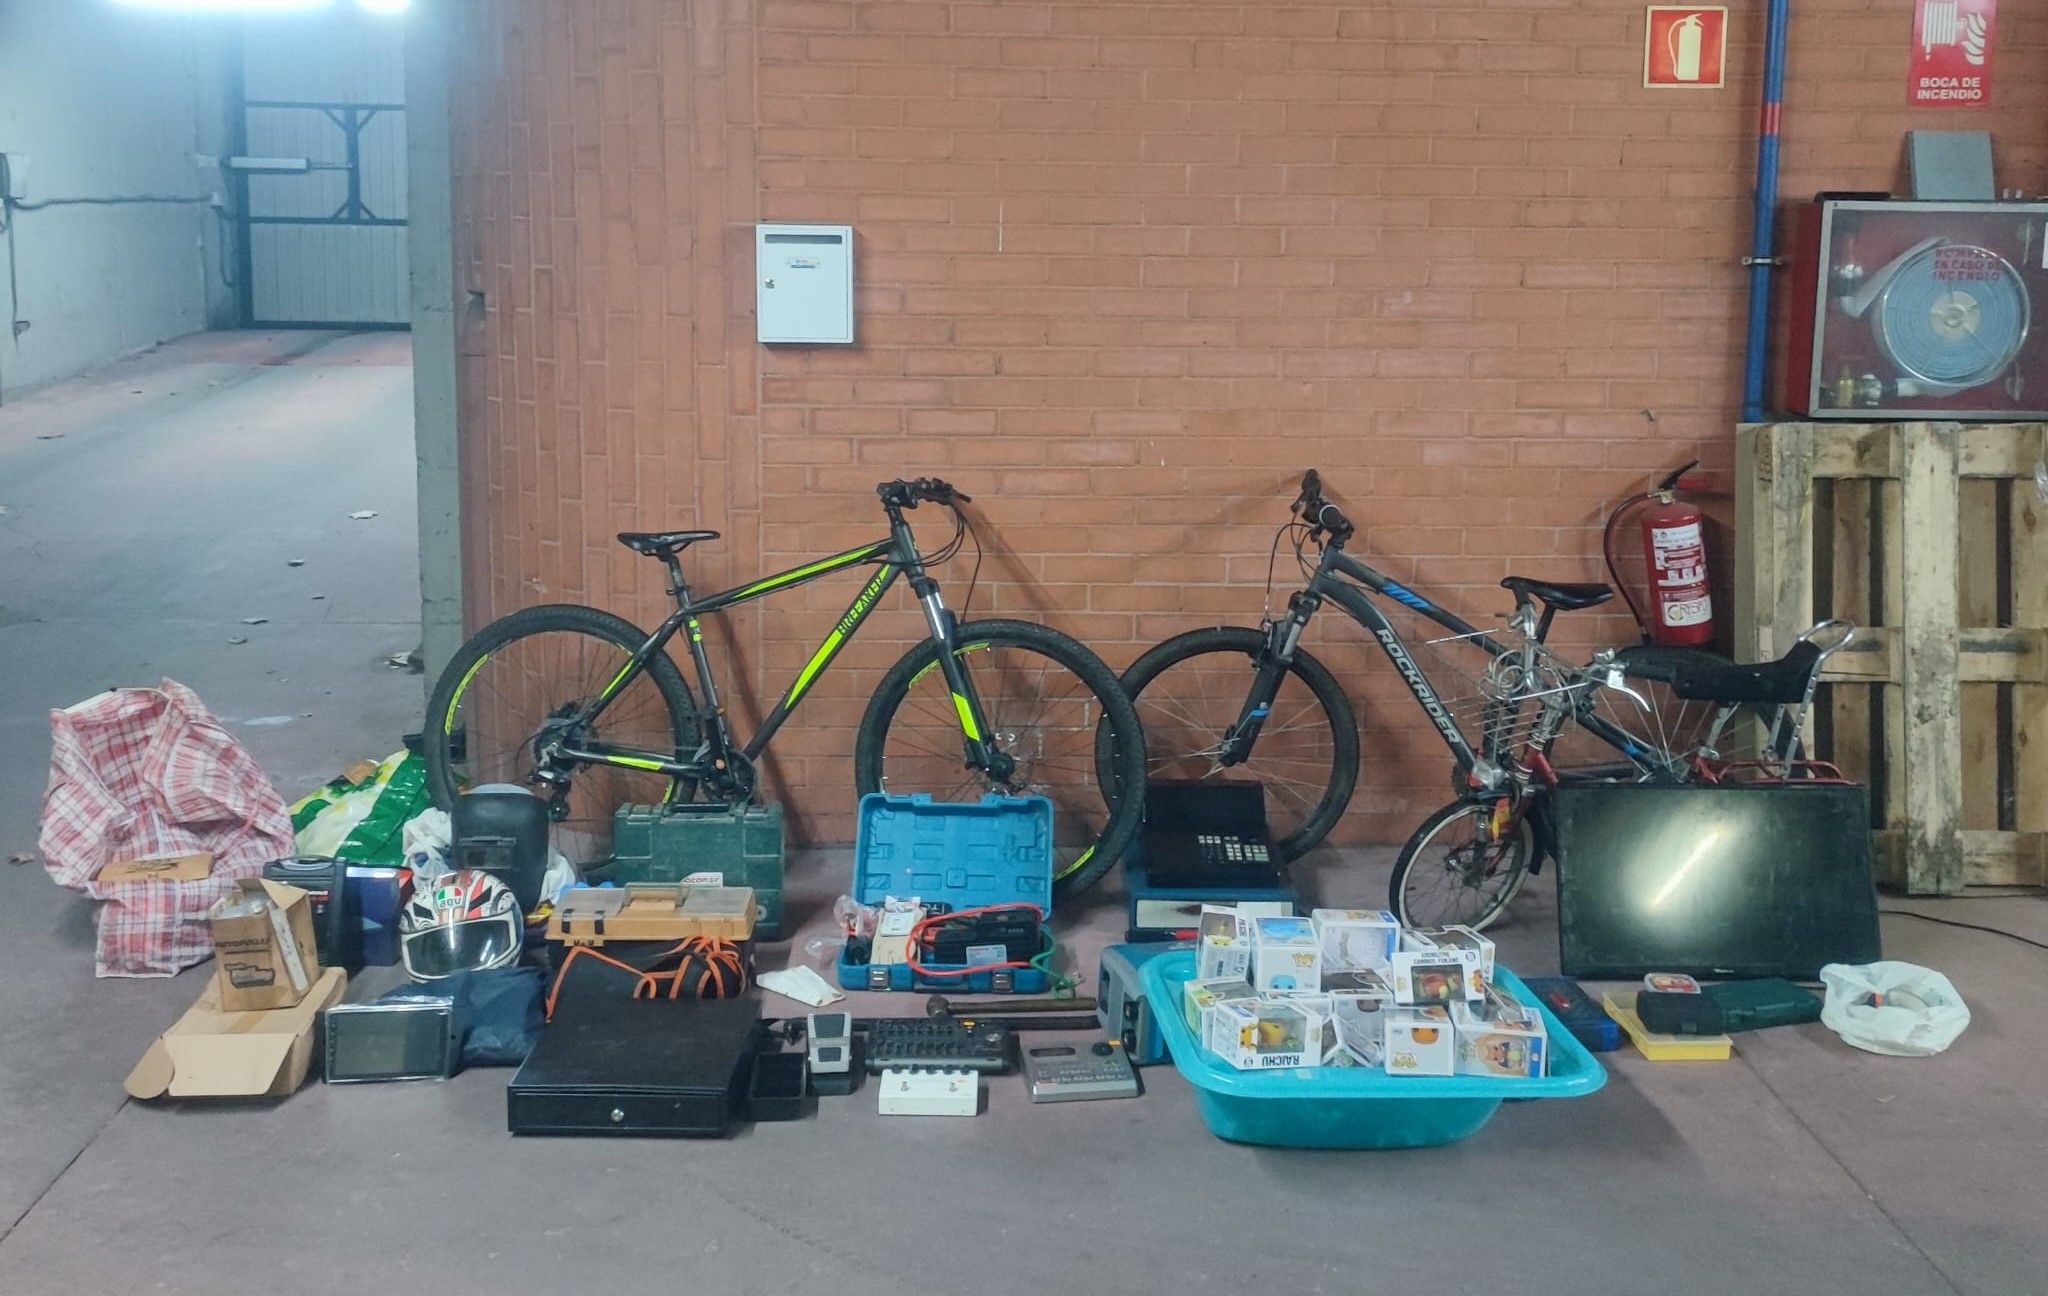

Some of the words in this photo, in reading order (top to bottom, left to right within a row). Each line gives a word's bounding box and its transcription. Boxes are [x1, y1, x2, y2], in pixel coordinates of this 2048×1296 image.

[1919, 77, 1959, 88] BOCA
[1962, 77, 1981, 87] DE
[1917, 89, 1982, 100] INCENDIO
[1376, 629, 1460, 743] ROCKRIDER
[1261, 1054, 1300, 1067] RAICHU
